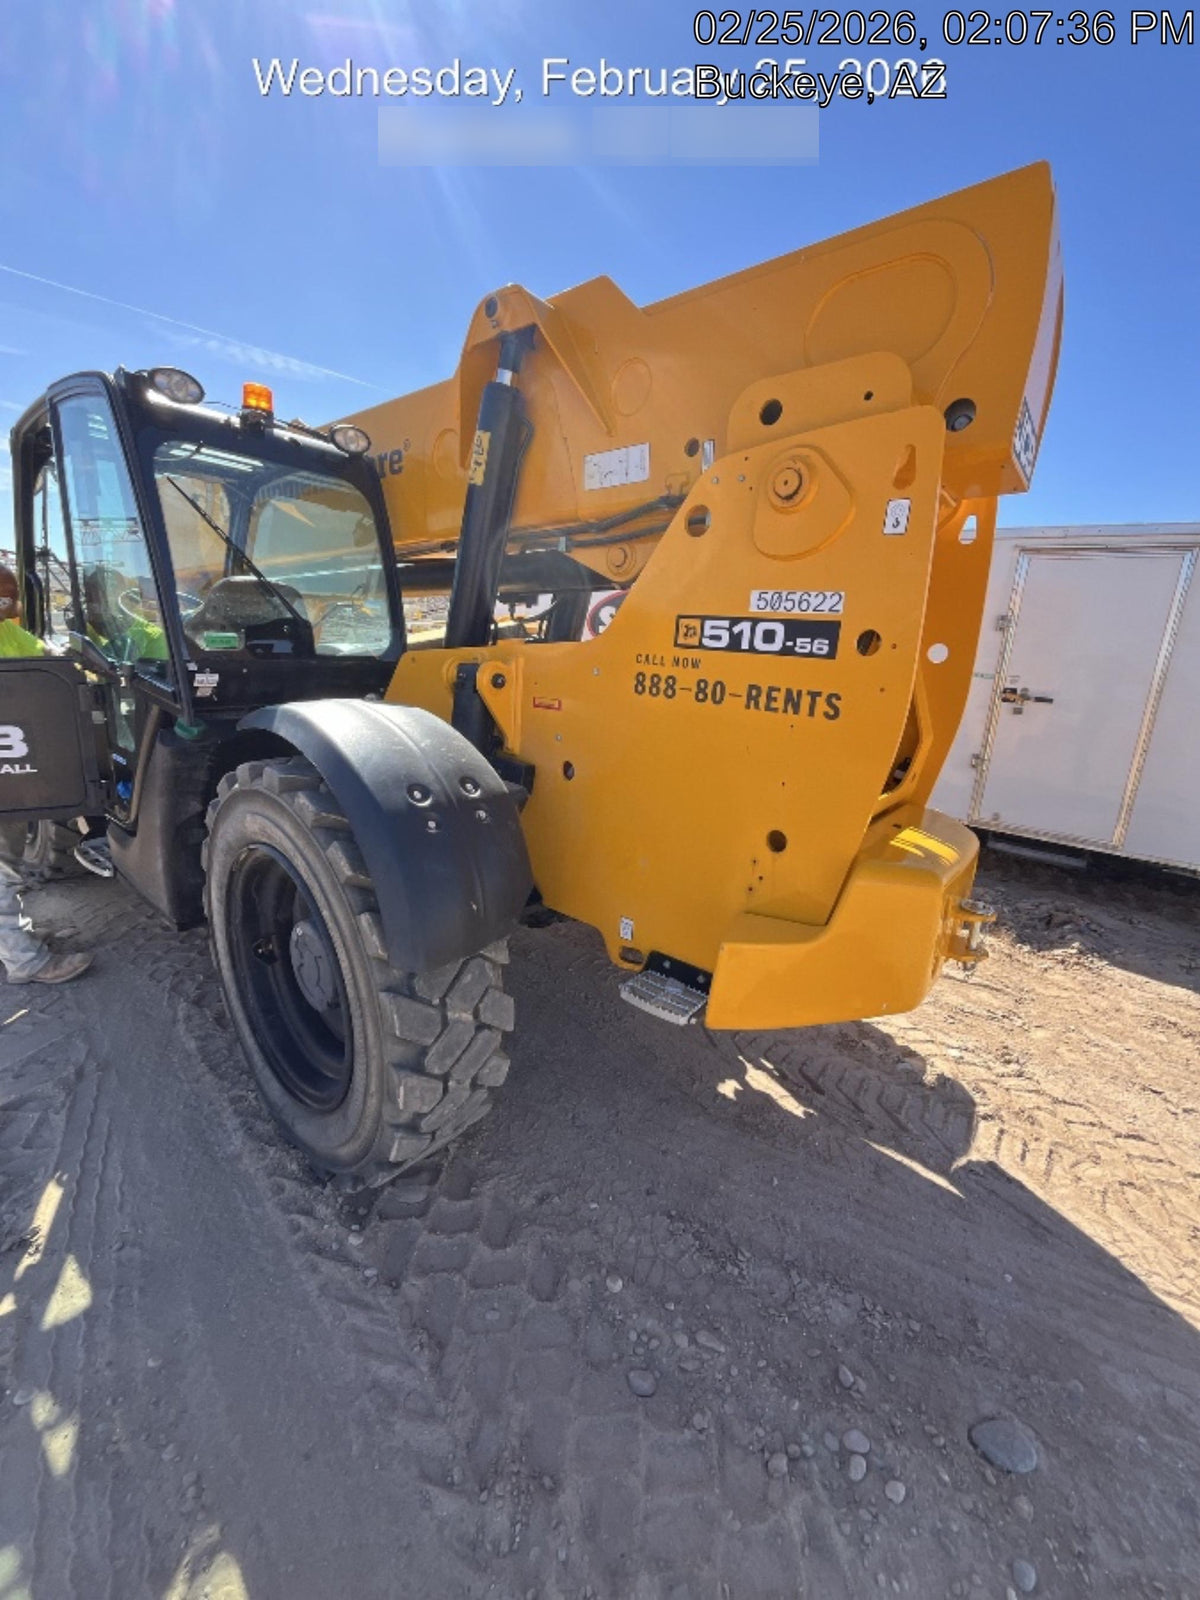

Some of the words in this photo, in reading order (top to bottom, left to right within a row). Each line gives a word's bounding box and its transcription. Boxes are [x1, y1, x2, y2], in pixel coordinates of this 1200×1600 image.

[756, 591, 843, 613] 505622
[636, 653, 666, 667] CALL
[672, 656, 702, 669] NOW
[633, 671, 842, 721] 888-80-RENTS
